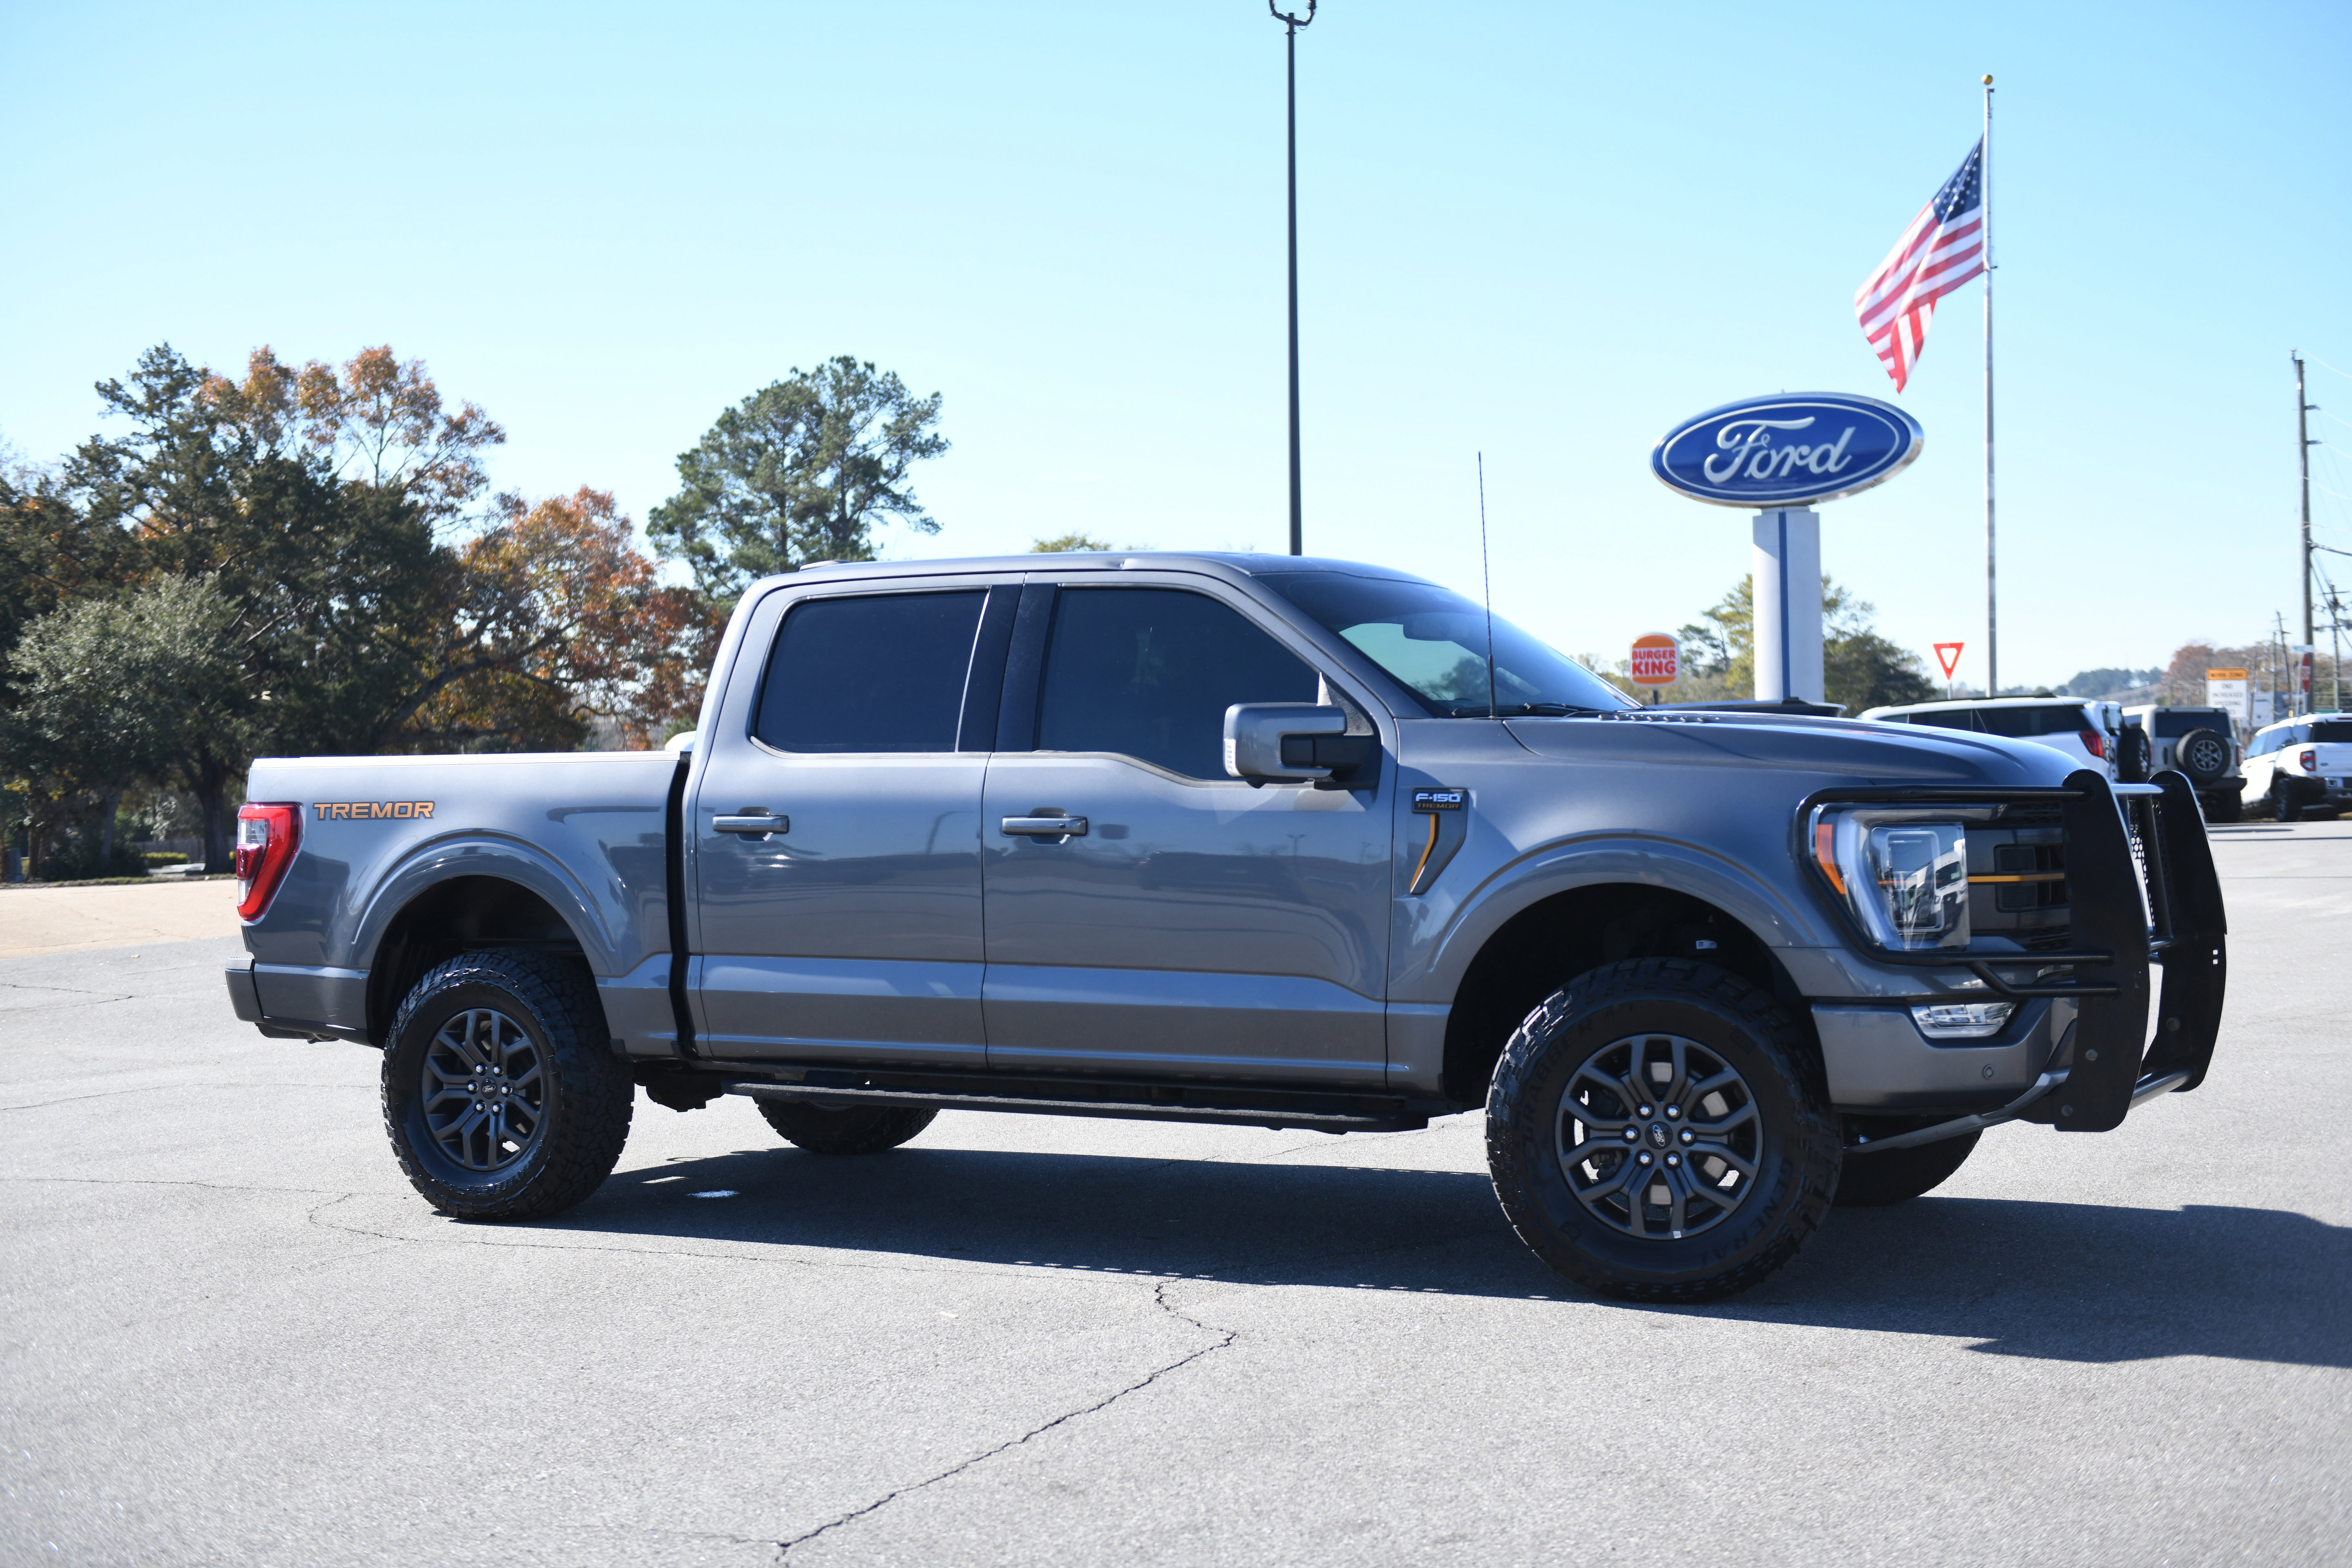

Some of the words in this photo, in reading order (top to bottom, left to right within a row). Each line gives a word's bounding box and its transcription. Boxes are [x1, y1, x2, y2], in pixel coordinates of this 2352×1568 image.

[1704, 416, 1856, 483] Ford
[1632, 650, 1676, 660] BURGER
[1632, 661, 1676, 675] KING
[1415, 793, 1461, 802] F-150
[314, 802, 434, 820] TREMOR
[1655, 1128, 1664, 1143] Ford
[1700, 1156, 1794, 1265] GENERAL
